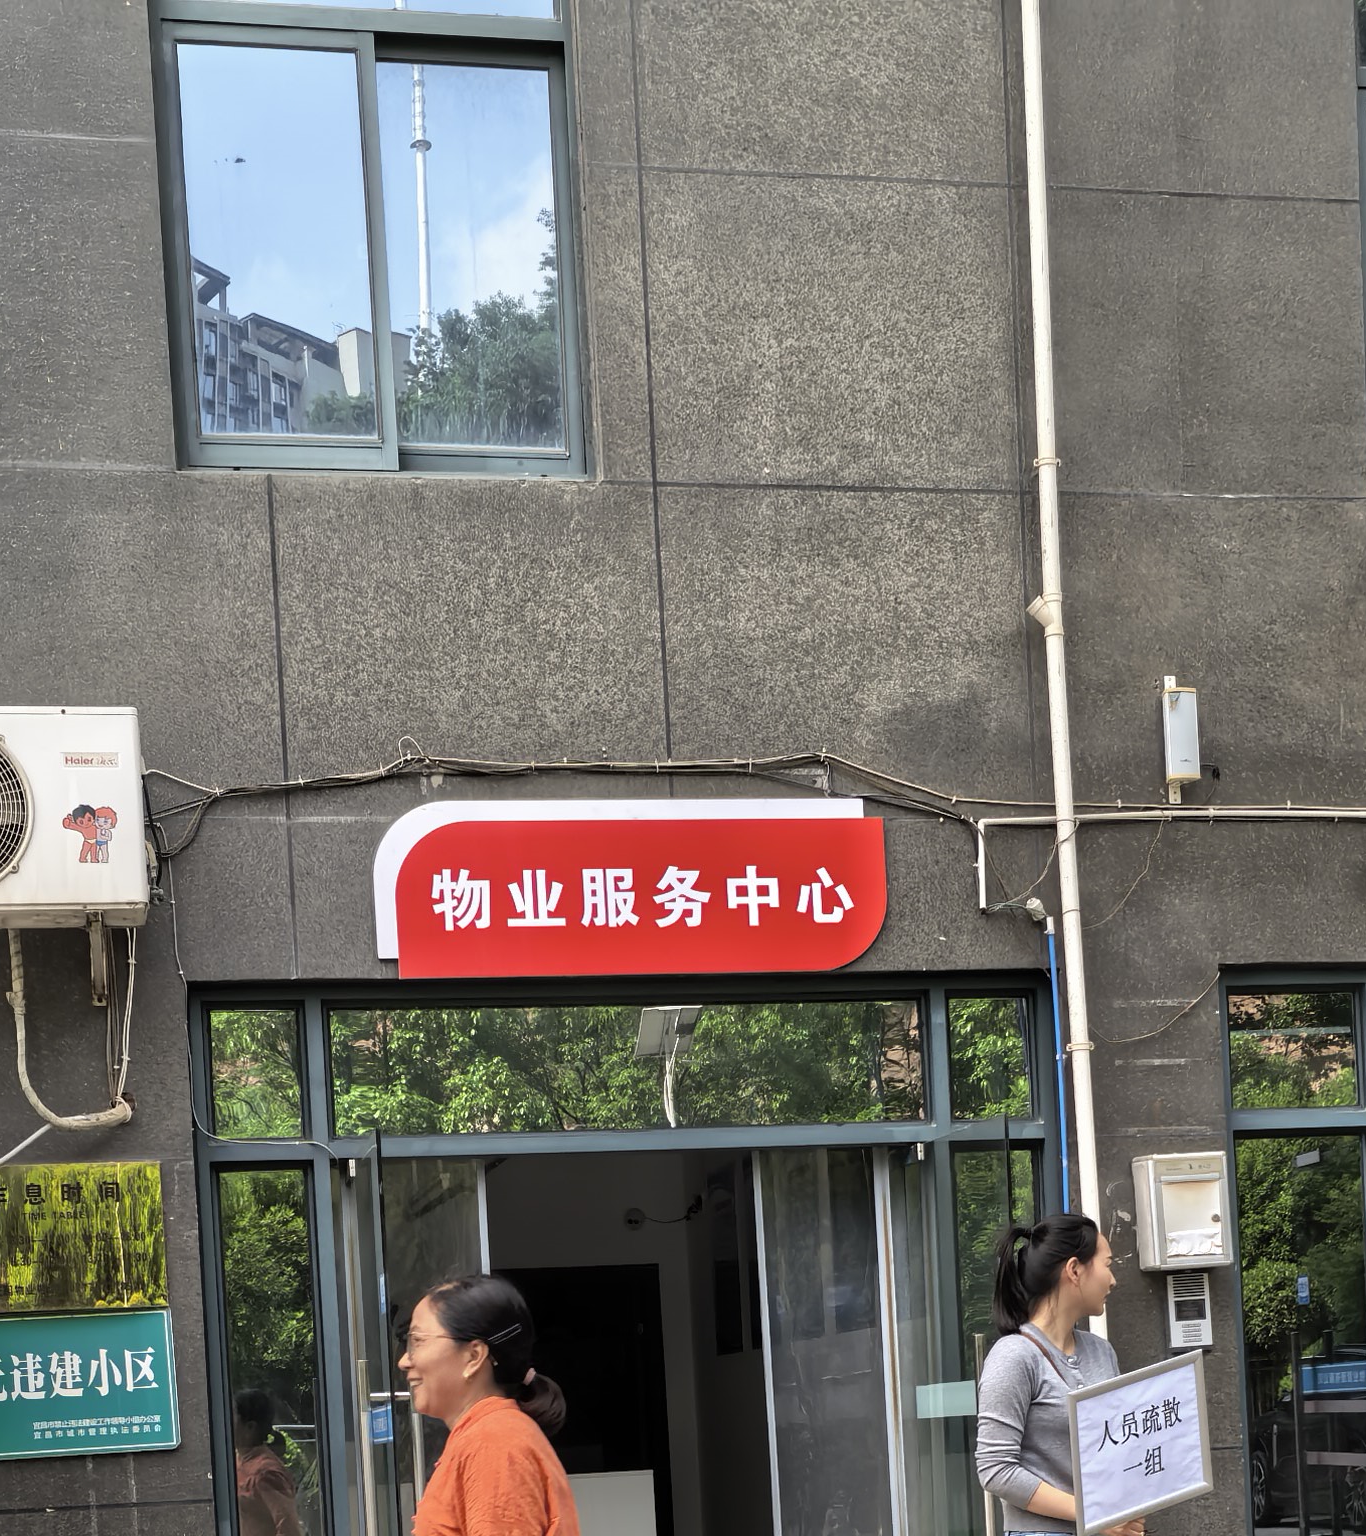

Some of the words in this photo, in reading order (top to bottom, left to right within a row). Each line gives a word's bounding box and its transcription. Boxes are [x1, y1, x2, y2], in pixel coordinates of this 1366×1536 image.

[430, 865, 855, 932] 物业服务中心
[1098, 1396, 1183, 1452] 人员疏散
[1123, 1446, 1164, 1476] 一组
